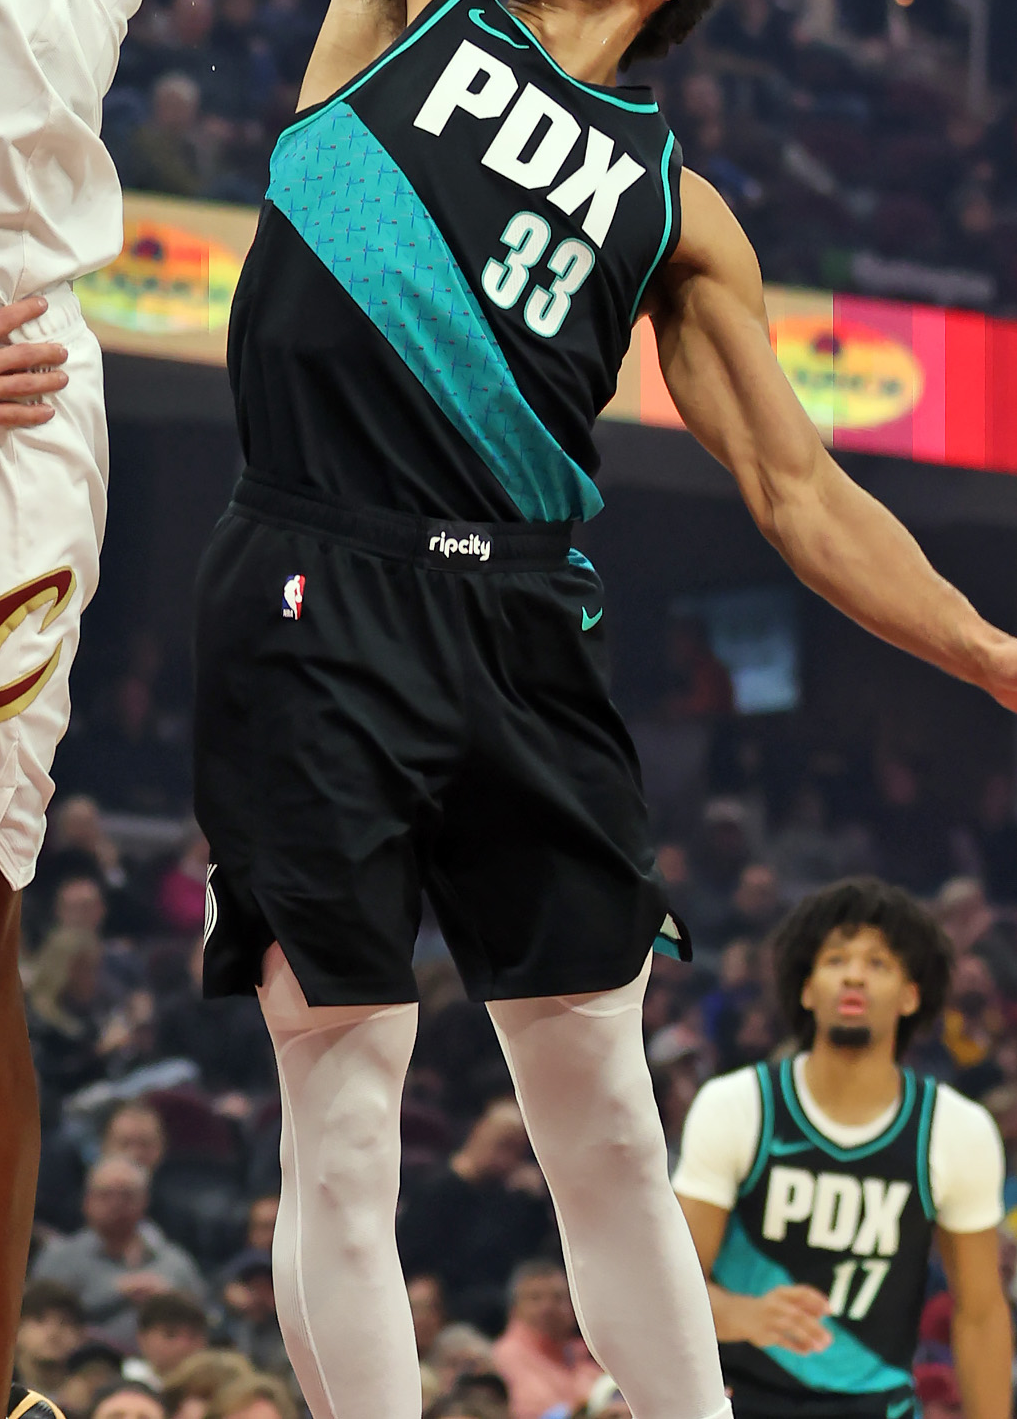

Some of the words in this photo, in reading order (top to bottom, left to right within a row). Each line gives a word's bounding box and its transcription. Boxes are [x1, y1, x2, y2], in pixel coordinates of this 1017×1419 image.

[413, 39, 646, 249] PDX
[481, 210, 596, 338] 33
[429, 531, 491, 561] ripcity
[762, 1166, 911, 1257] PDX
[829, 1259, 891, 1321] 17
